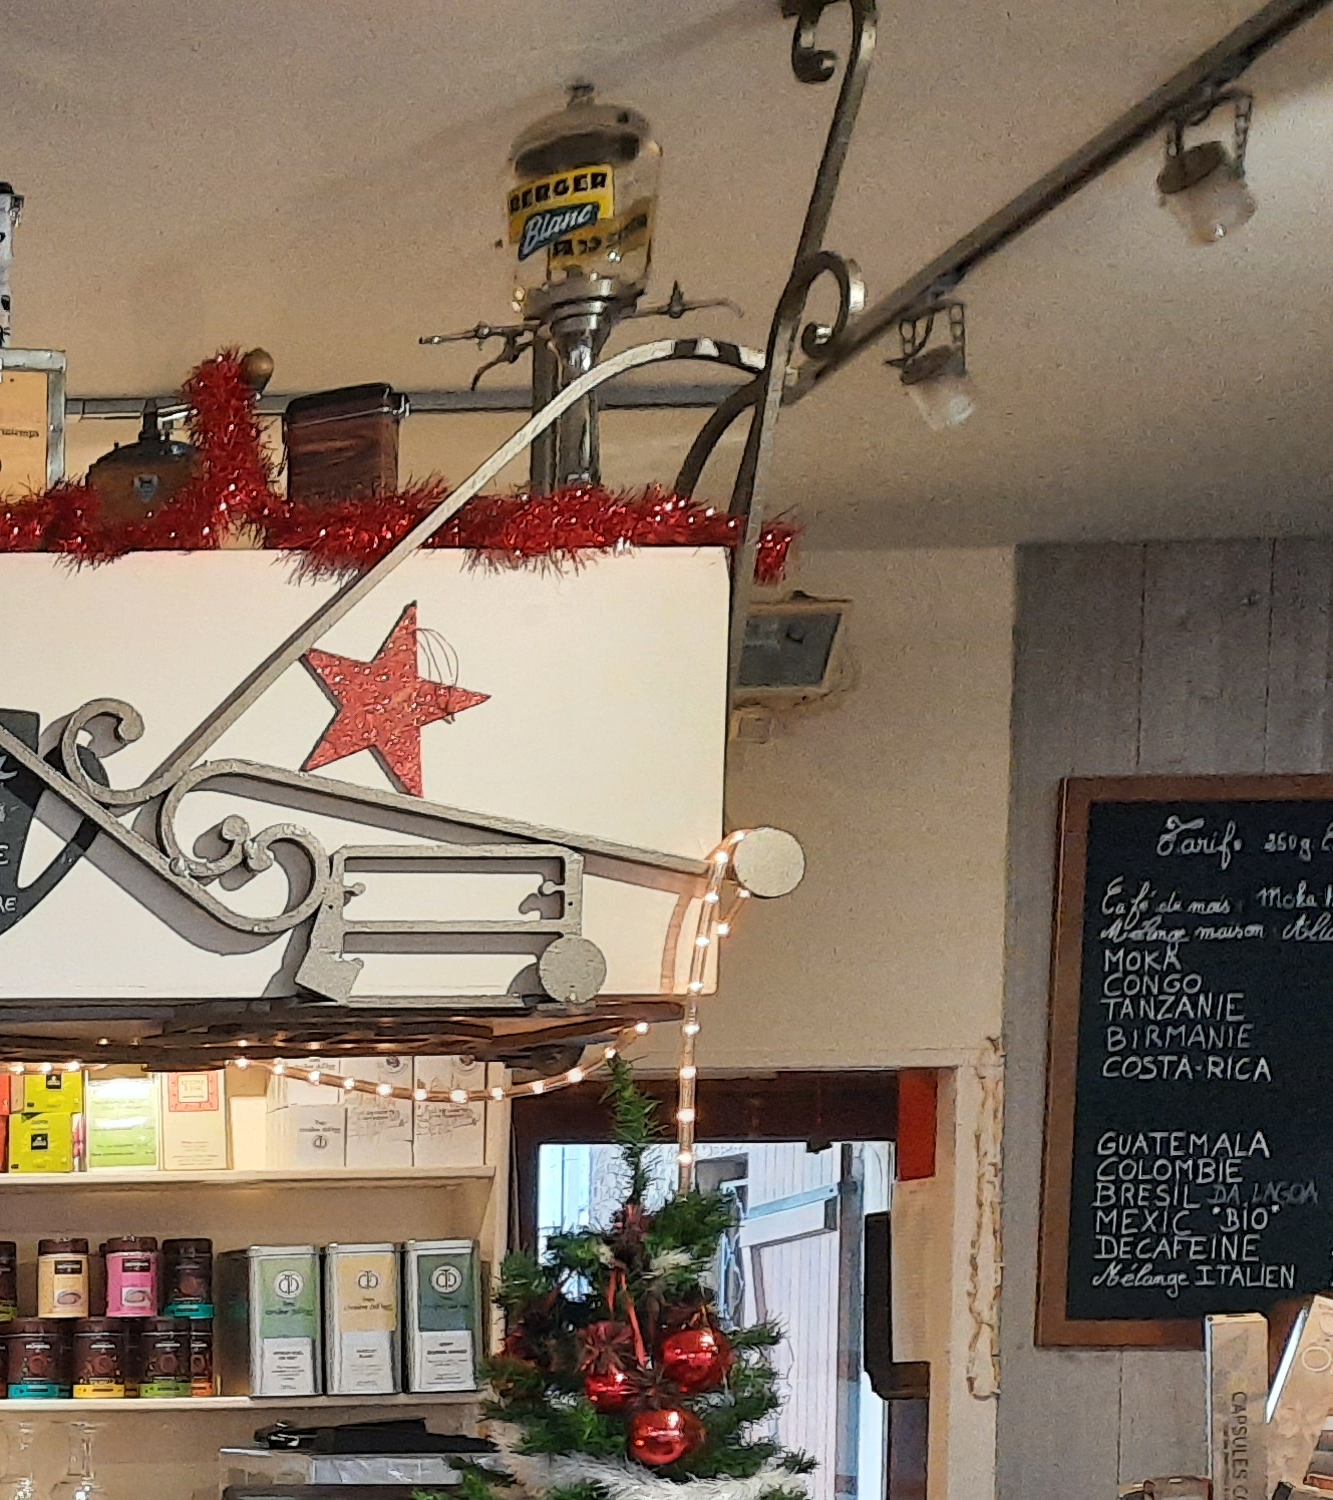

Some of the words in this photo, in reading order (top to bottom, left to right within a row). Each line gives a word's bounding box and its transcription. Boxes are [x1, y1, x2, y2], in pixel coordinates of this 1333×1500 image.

[509, 172, 608, 213] BERGER
[521, 203, 595, 257] Blanc
[1102, 947, 1183, 973] MOKA
[1102, 972, 1203, 997] CONGO
[1099, 992, 1246, 1022] TANZANIE
[1106, 1023, 1255, 1052] BIRMANIE
[1101, 1054, 1273, 1083] COSTA-RICA
[1096, 1129, 1272, 1159] GUATEMALA
[1095, 1156, 1244, 1184] COLOMBIE
[1090, 1181, 1202, 1209] BRESIL
[1095, 1206, 1193, 1237] MEXIC
[1092, 1233, 1262, 1262] DECAFEINE
[1091, 1260, 1191, 1299] Mélange
[1194, 1263, 1296, 1289] ITALIEN
